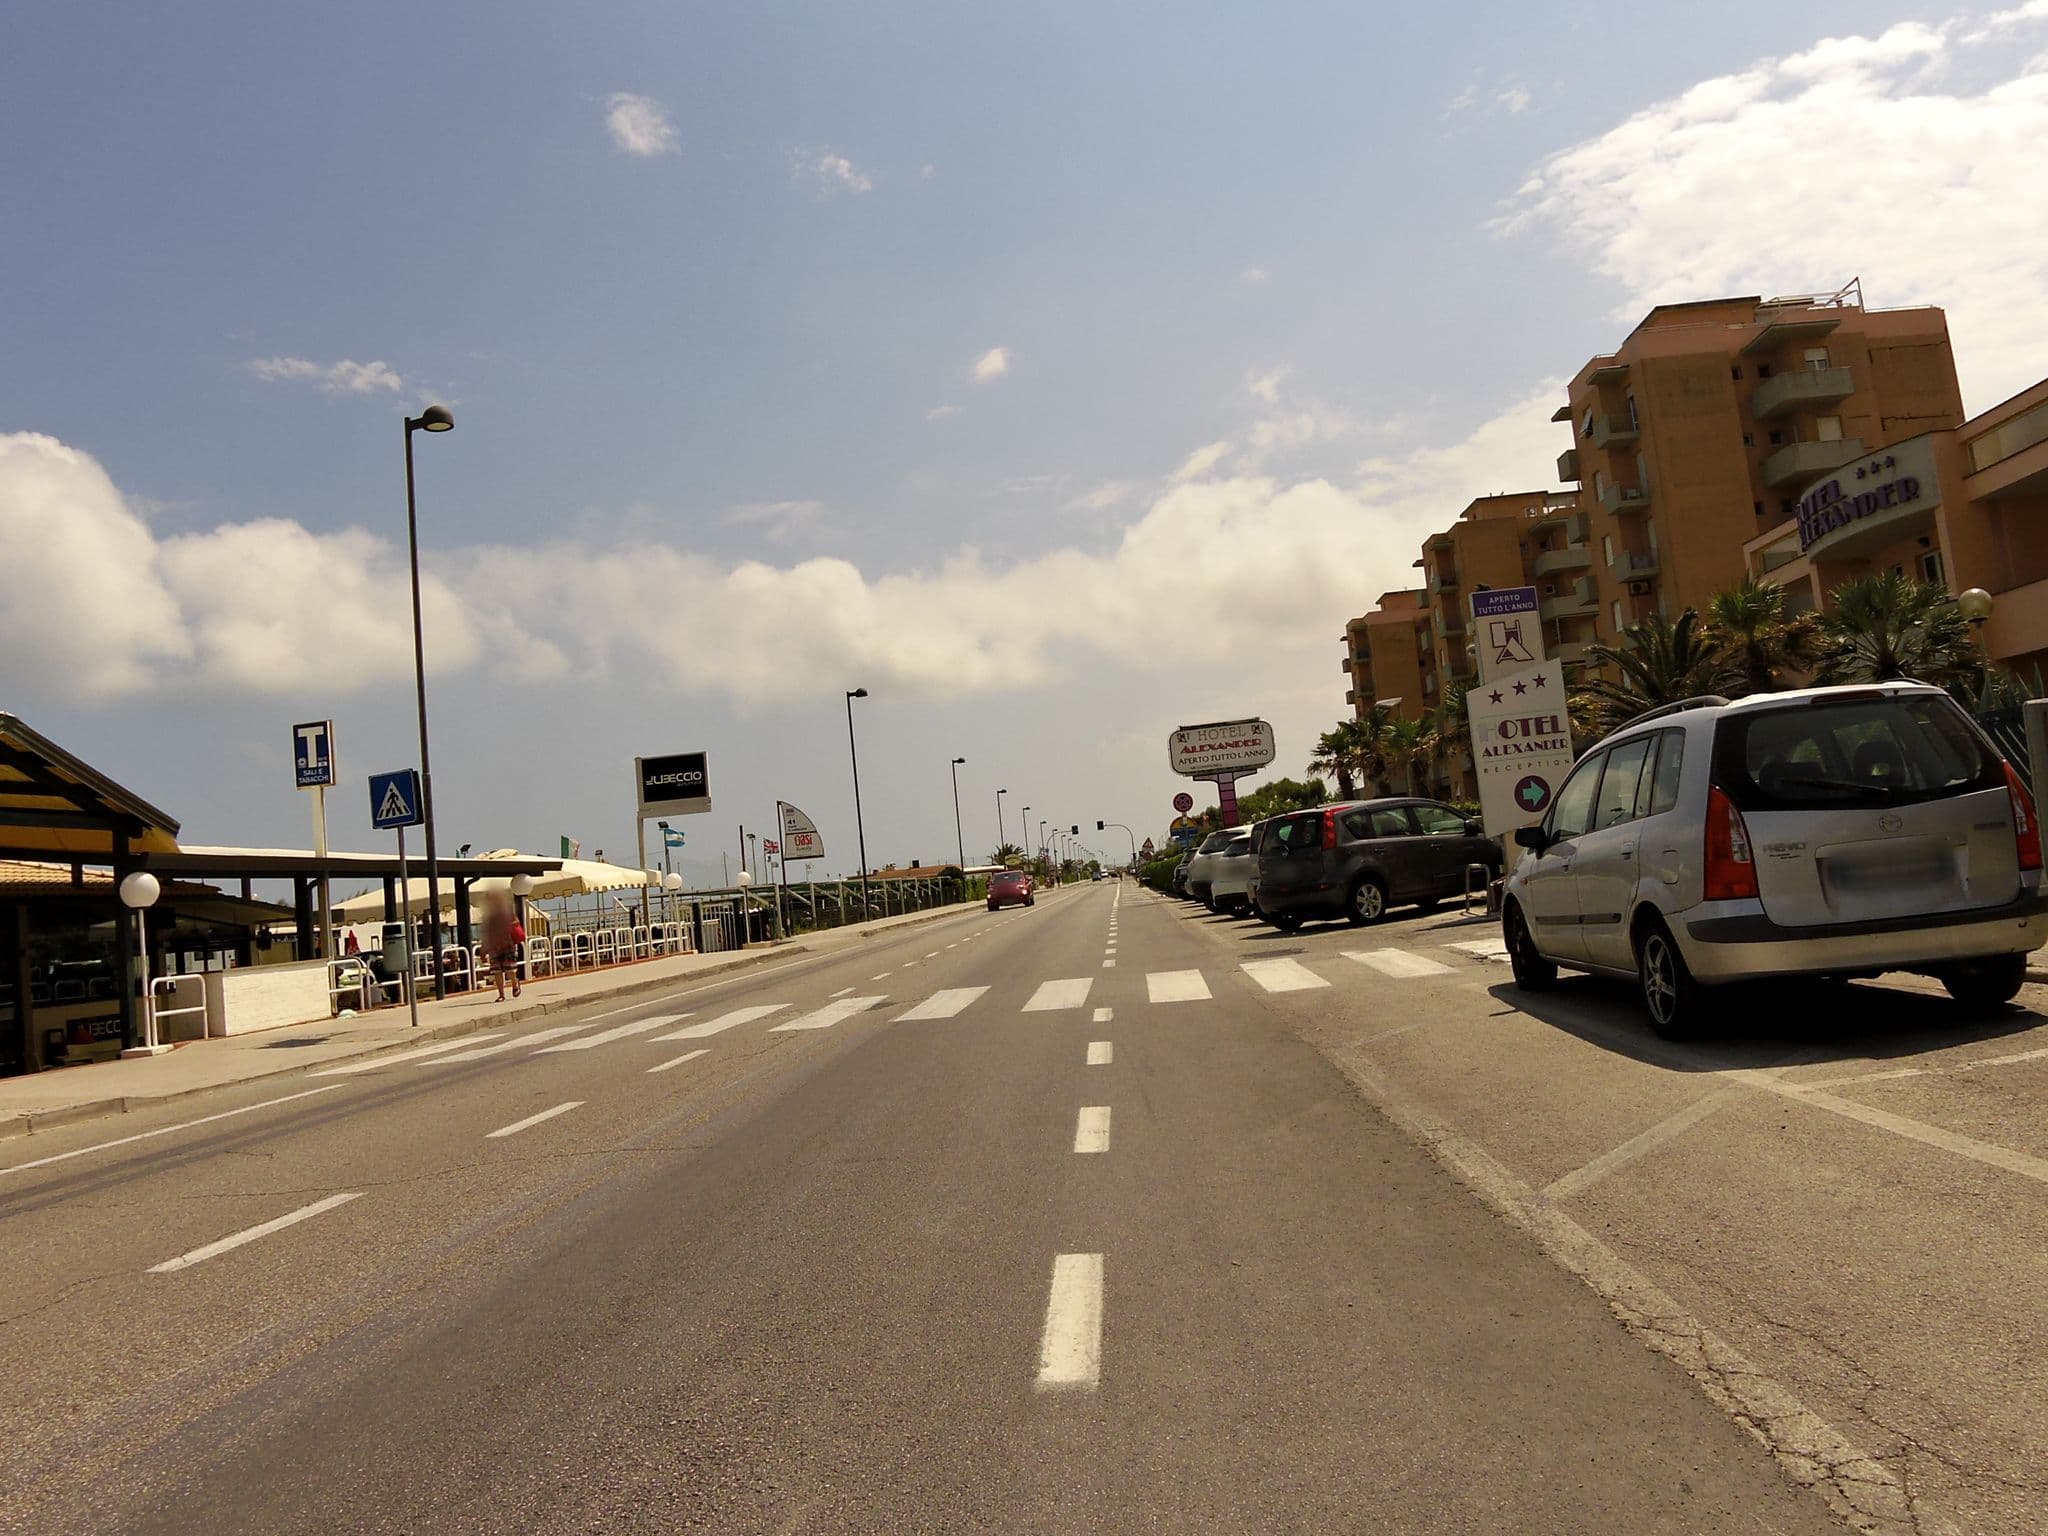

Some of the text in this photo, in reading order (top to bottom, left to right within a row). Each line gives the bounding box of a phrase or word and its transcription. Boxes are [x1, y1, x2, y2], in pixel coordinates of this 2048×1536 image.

[1489, 594, 1520, 604] APERTO
[1478, 605, 1503, 614] TUTTO
[1198, 726, 1246, 742] HOTEL
[297, 726, 324, 768] T
[1180, 738, 1262, 754] ALEXANDER
[1482, 738, 1568, 758] ALEXANDER
[1179, 755, 1209, 766] APERTO
[1210, 752, 1236, 762] TUTTO
[1484, 759, 1570, 773] RECEPTION
